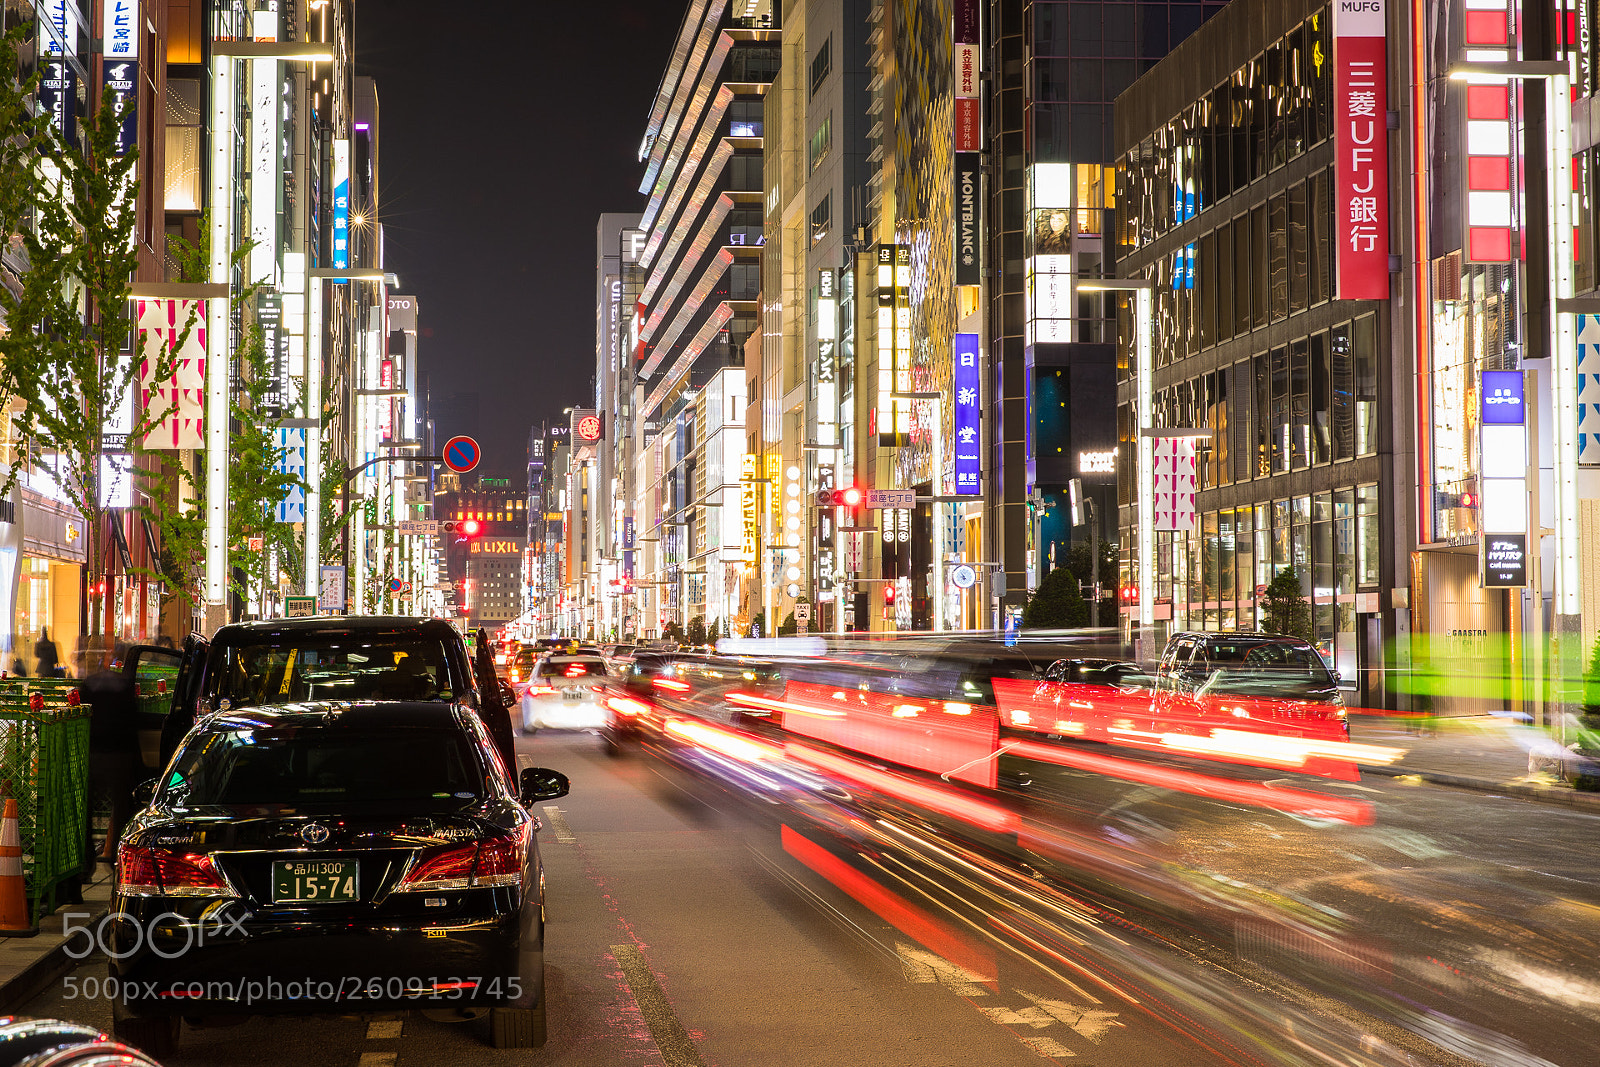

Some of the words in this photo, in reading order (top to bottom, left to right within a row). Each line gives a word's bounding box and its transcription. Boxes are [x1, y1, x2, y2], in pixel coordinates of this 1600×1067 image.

[1341, 2, 1380, 12] MUFG
[962, 48, 972, 93] 共立美容外科
[963, 101, 971, 148] 東京美容外科
[1348, 62, 1378, 252] 三菱UFJ銀行
[961, 171, 974, 254] MONTBLANC
[819, 342, 834, 380] ダンス
[958, 352, 978, 444] 日新堂
[551, 427, 572, 435] BV
[1080, 452, 1114, 462] MONT
[1080, 462, 1114, 472] BLANC
[870, 494, 913, 503] 銀座七丁目
[743, 471, 754, 553] ライオンビヤホール
[484, 541, 519, 553] LIXIL
[1452, 629, 1487, 637] GAASTRA
[279, 883, 289, 894] こ
[295, 876, 355, 899] 15-74
